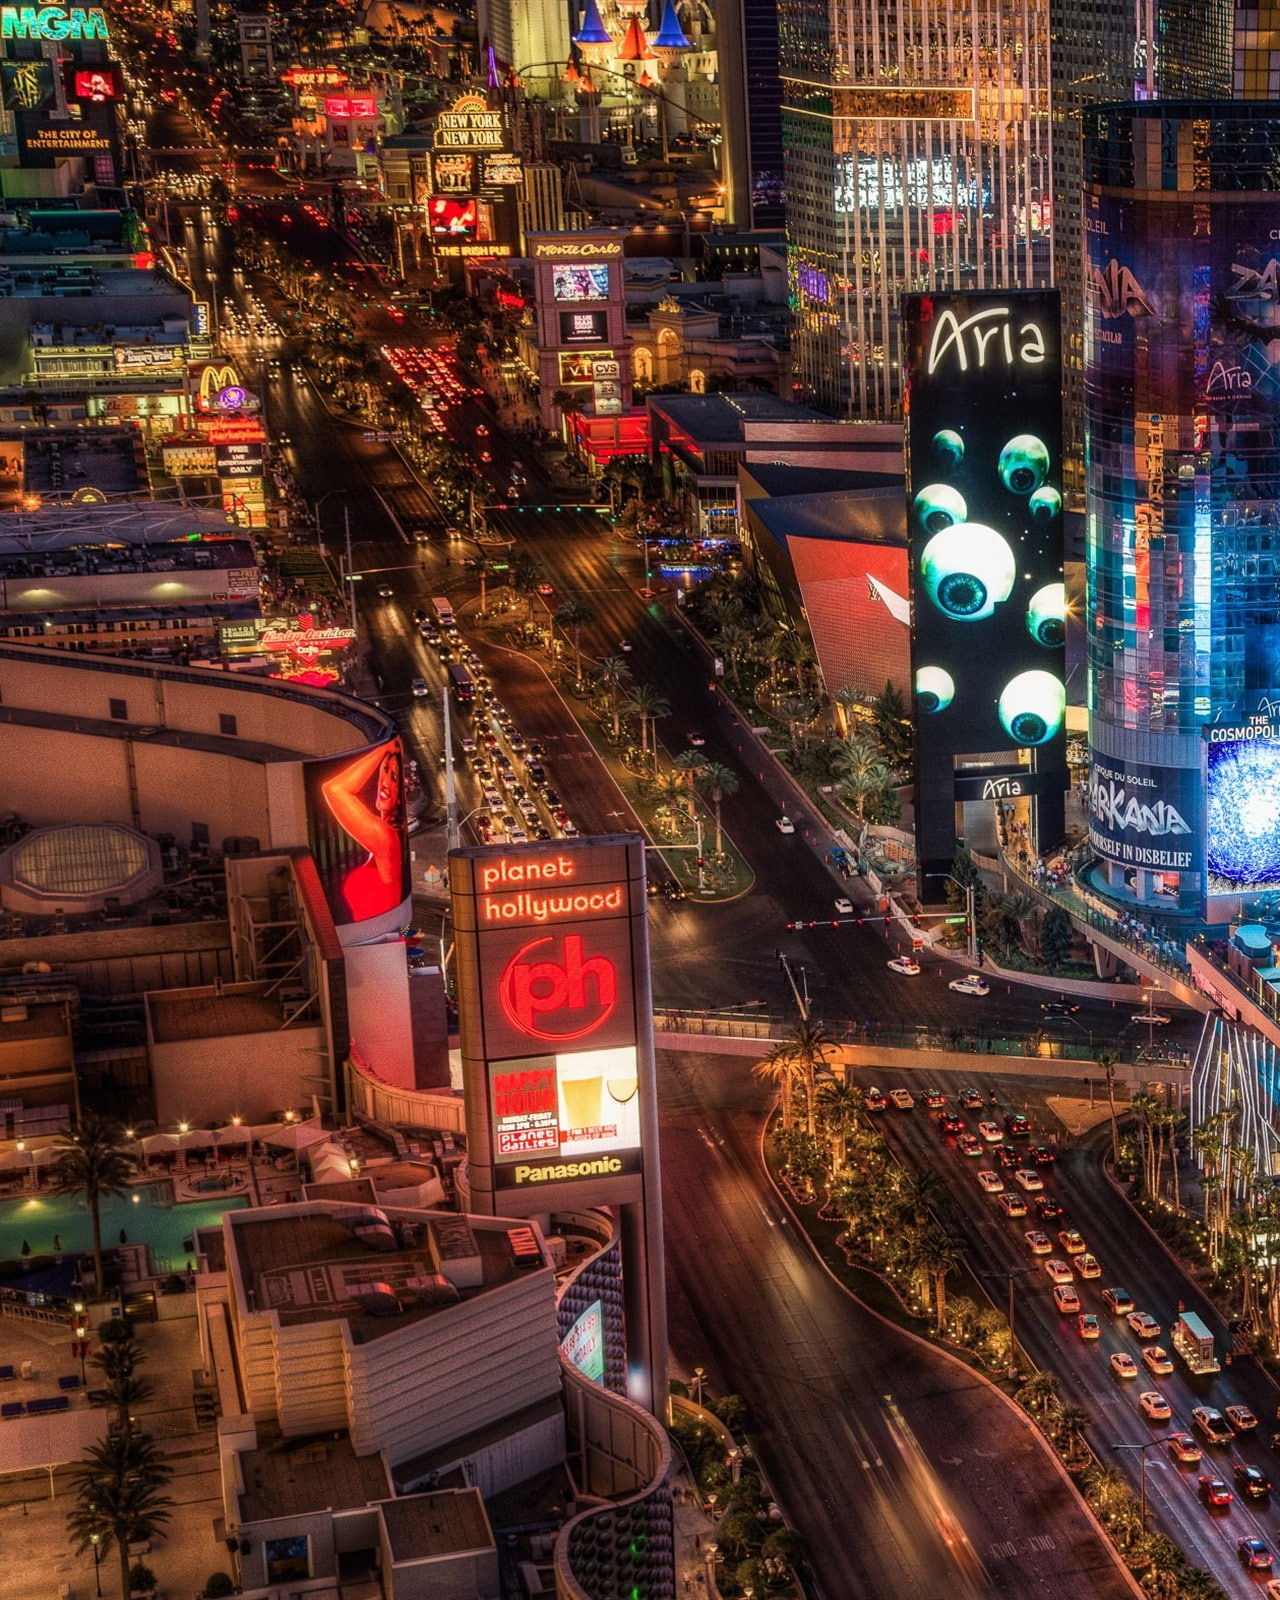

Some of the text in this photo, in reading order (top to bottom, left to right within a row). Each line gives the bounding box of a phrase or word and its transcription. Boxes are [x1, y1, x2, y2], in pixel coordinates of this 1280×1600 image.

[1, 6, 110, 40] MGM
[442, 114, 468, 128] NEW
[469, 114, 502, 128] YORK
[26, 139, 111, 148] ENTERTAINMENT
[37, 130, 98, 139] THE CITY OF
[443, 131, 504, 145] NEW YORK
[439, 246, 511, 256] THE IRISH PUB
[536, 242, 622, 256] Monte Carlo
[928, 307, 1046, 374] Aria
[595, 363, 617, 373] CVS
[1206, 361, 1252, 394] Aria
[1249, 716, 1269, 725] THE
[1094, 763, 1158, 788] CIRQUE DU SOLEIL
[982, 777, 1021, 800] Aria
[1122, 843, 1133, 861] IN
[1135, 846, 1193, 868] DISBELIEF
[484, 857, 574, 890] planet
[485, 886, 622, 921] hollywood
[513, 935, 617, 1028] ph
[494, 1067, 556, 1093] HAPPY
[495, 1088, 558, 1117] HOUR
[515, 1156, 622, 1183] Panasonic
